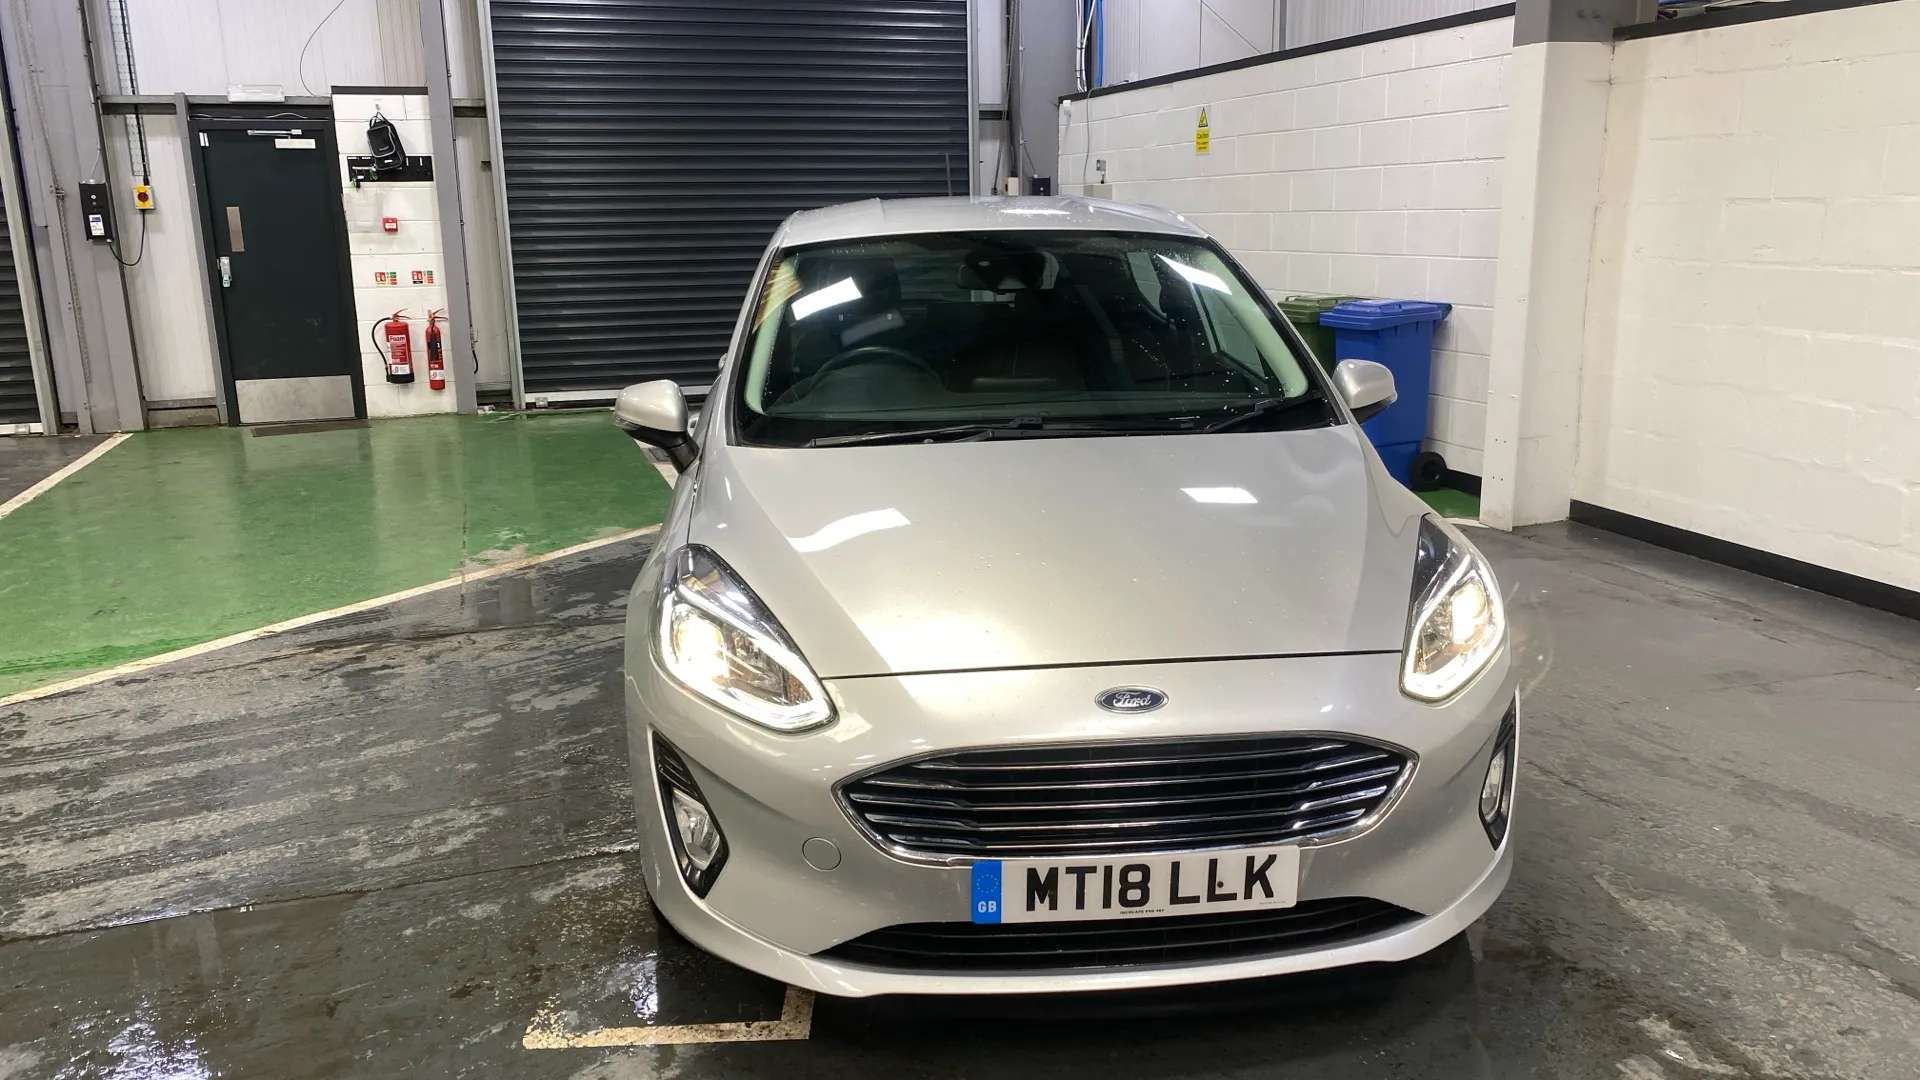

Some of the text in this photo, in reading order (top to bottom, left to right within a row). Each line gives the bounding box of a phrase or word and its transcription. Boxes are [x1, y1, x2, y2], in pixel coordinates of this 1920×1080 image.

[1112, 692, 1152, 707] Ford
[1169, 854, 1277, 906] LLK
[977, 901, 997, 913] GB
